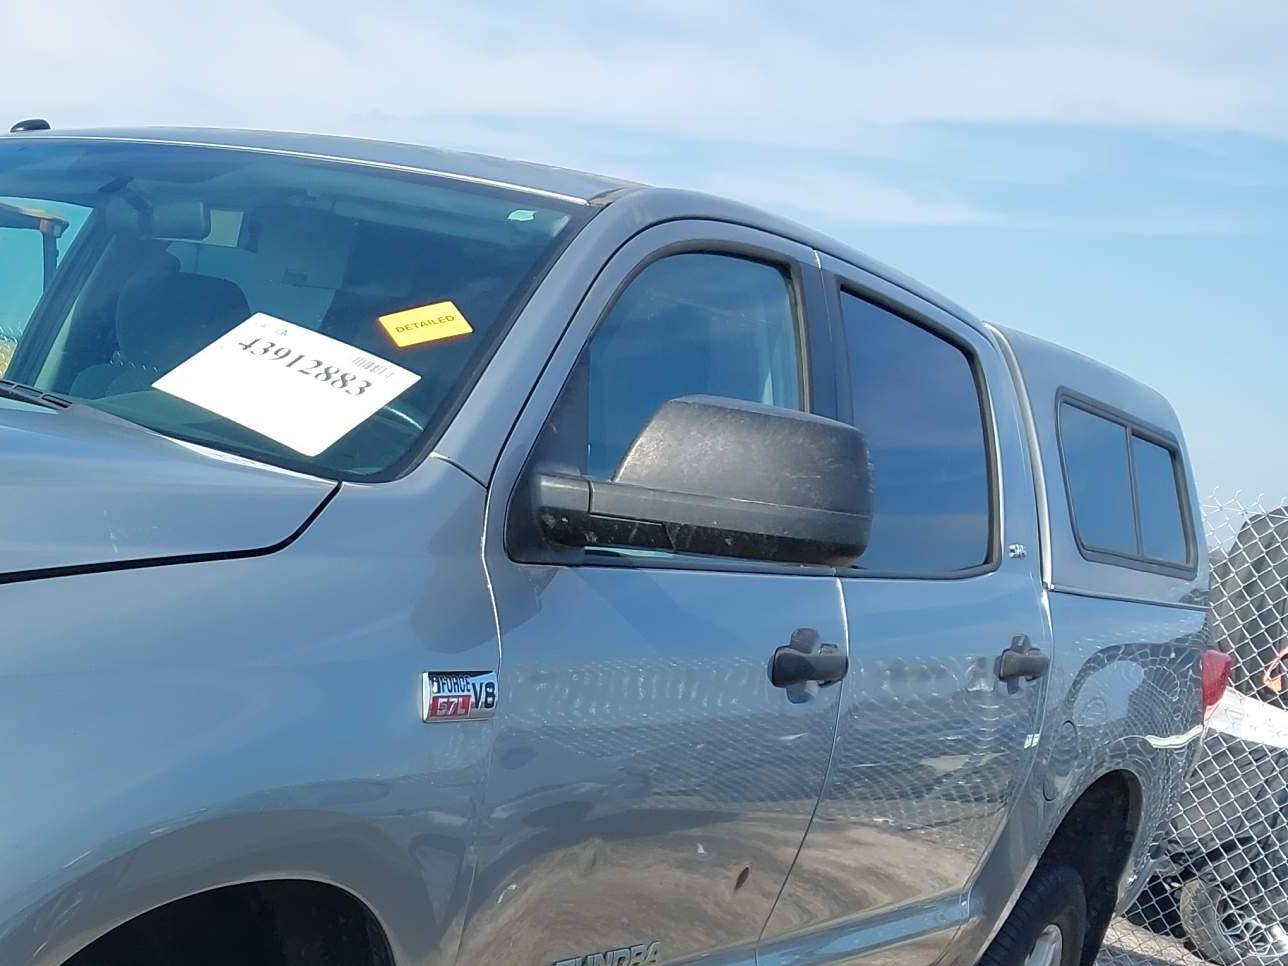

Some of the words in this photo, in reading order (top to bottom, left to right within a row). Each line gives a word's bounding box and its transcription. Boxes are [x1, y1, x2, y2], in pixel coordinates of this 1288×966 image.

[395, 315, 455, 333] DETAILED
[238, 337, 373, 396] 43912883
[472, 681, 496, 709] V8
